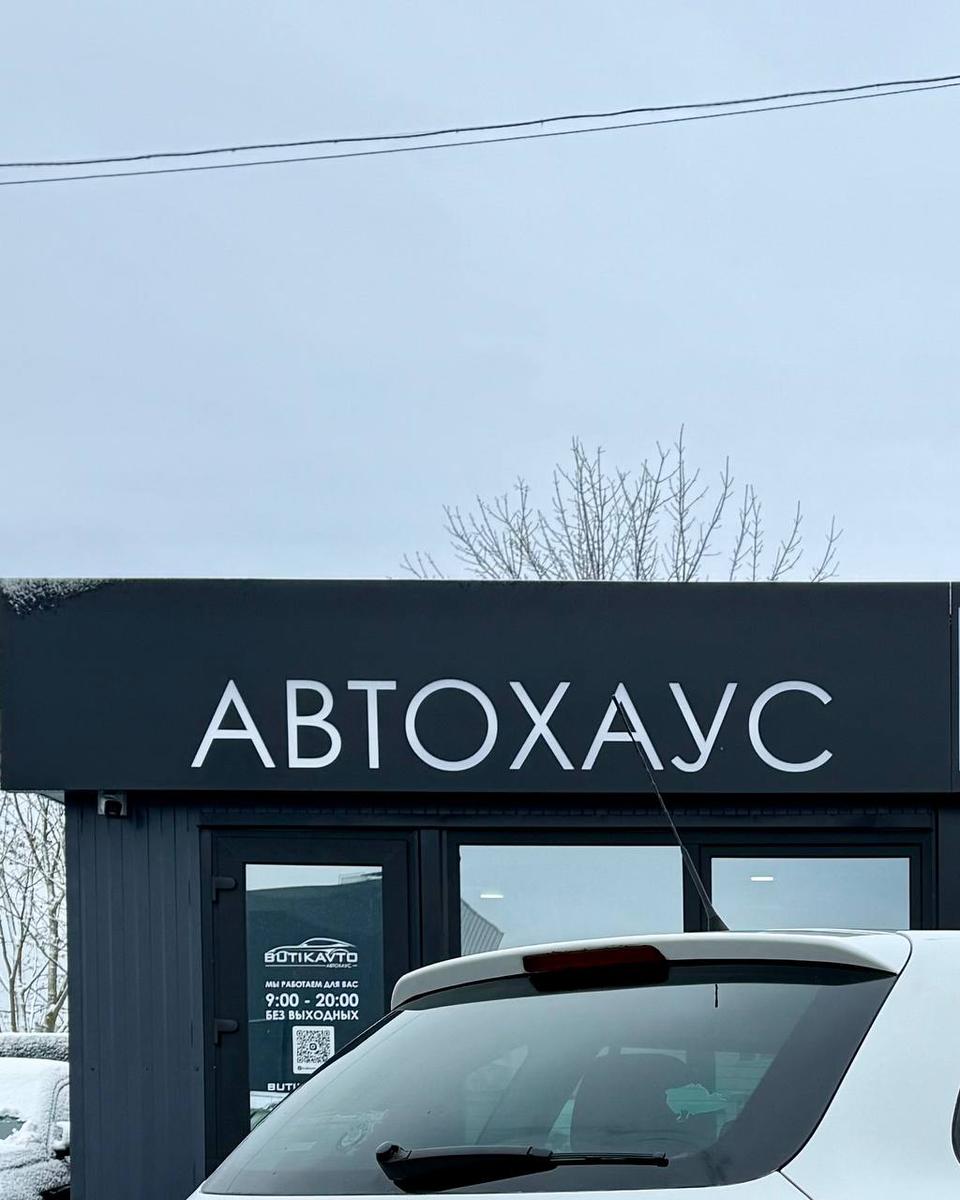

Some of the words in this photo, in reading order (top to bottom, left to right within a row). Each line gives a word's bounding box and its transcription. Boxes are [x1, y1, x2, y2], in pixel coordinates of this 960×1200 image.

[190, 678, 834, 773] АВТОХАУС
[264, 952, 358, 963] BUTIKAVTO
[323, 981, 340, 989] ДЛЯ
[265, 993, 300, 1007] 9:00
[315, 993, 359, 1007] 20:00
[265, 1010, 285, 1020] БЕЗ
[289, 1010, 359, 1021] ВЫХОДНЫХ
[267, 1082, 300, 1091] BUTI
